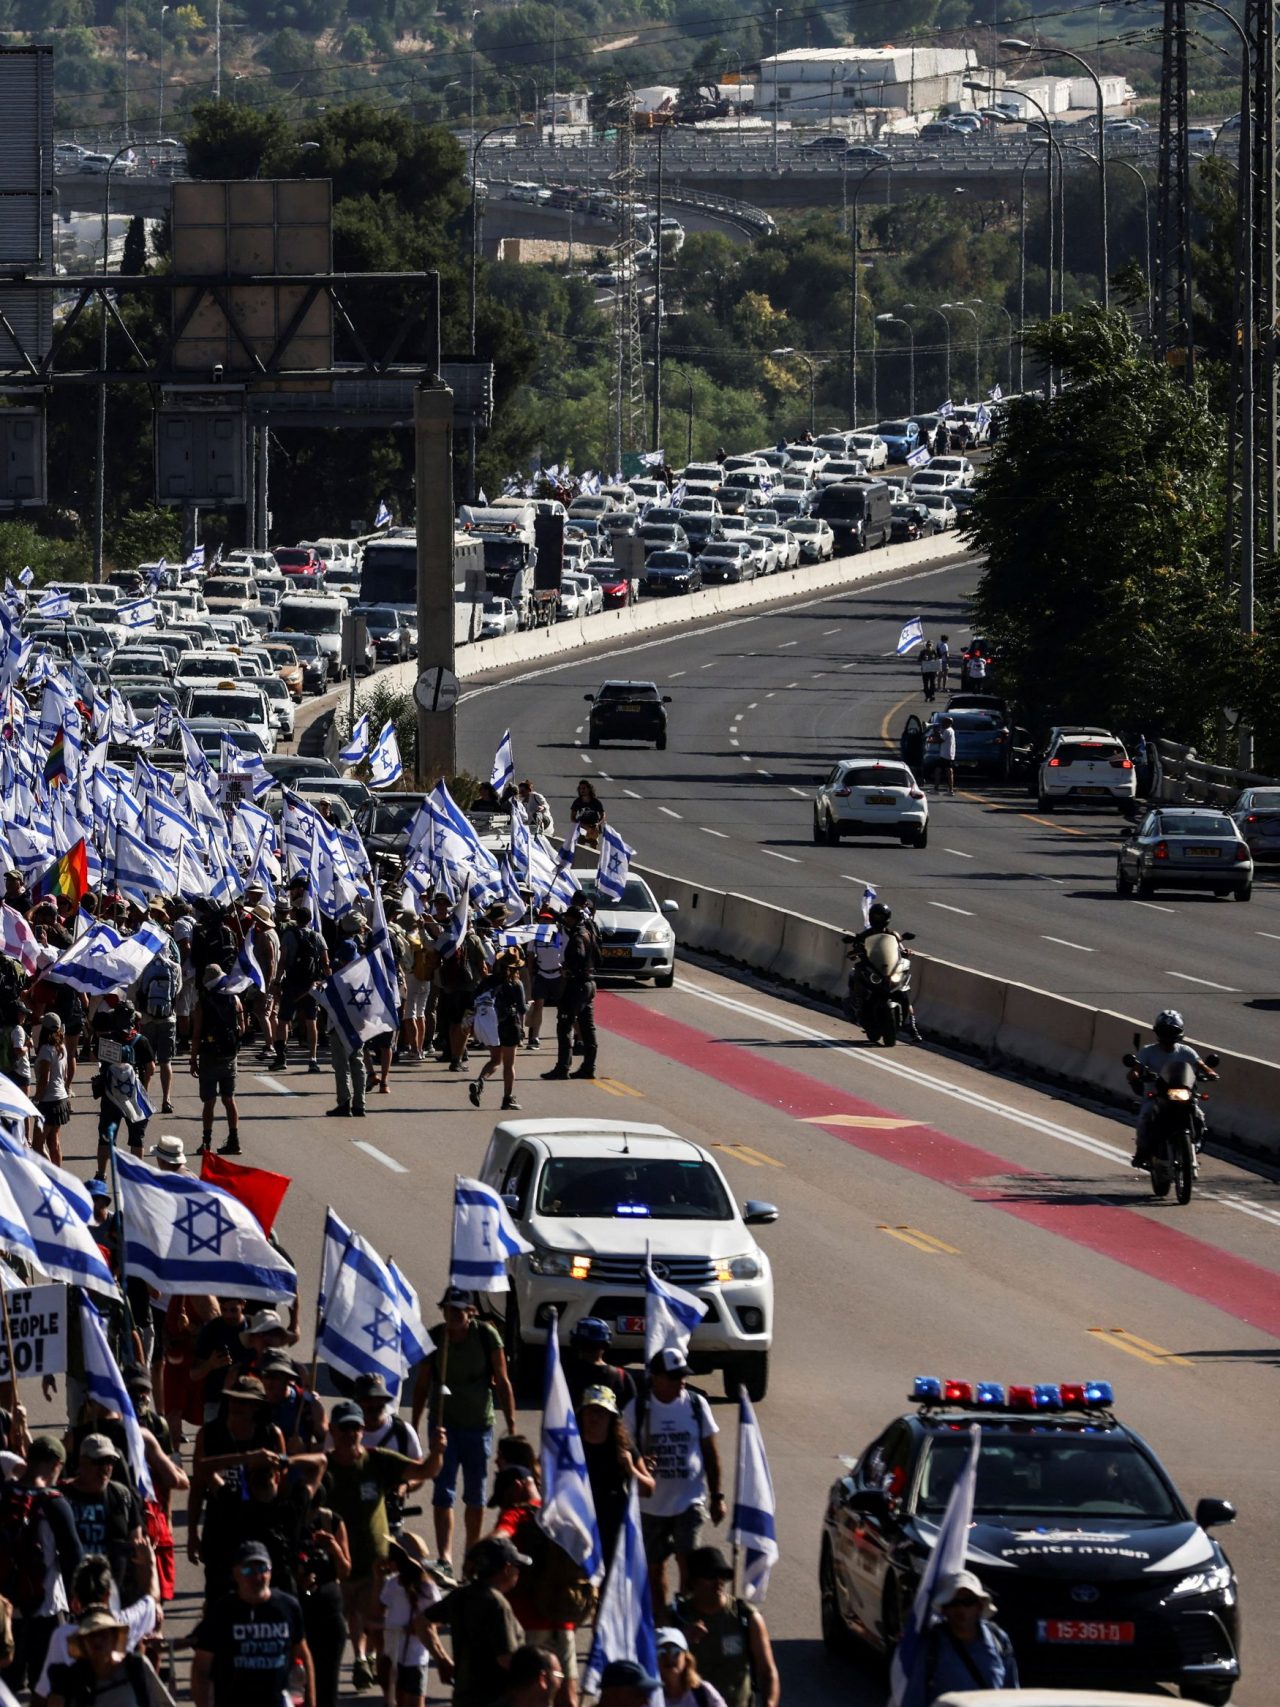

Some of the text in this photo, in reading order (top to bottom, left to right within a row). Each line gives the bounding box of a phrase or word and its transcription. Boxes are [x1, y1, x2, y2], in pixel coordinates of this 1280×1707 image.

[4, 1292, 32, 1316] LET
[1001, 1546, 1150, 1559] POLICE משטרה
[232, 1622, 290, 1641] נאמנים
